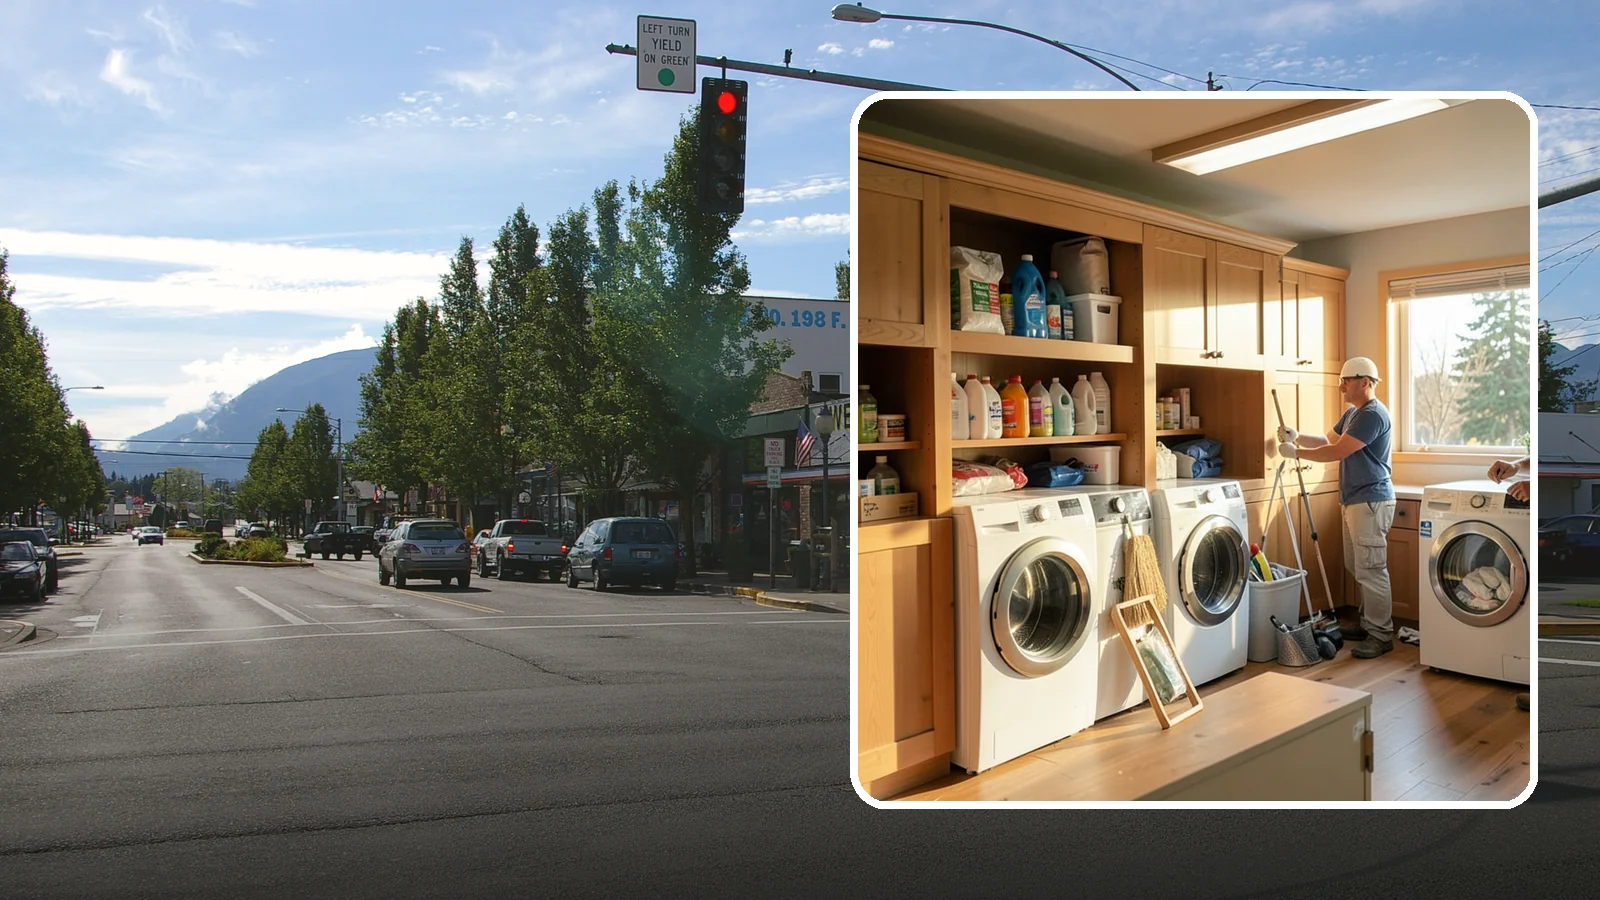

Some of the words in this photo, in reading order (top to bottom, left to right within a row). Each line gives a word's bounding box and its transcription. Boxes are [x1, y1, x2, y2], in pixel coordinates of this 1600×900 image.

[643, 24, 663, 34] LEFT
[668, 26, 690, 36] TURN
[652, 38, 682, 52] YIELD
[644, 53, 656, 64] ON
[661, 55, 689, 66] GREEN
[791, 309, 826, 328] 198
[831, 311, 846, 329] F.
